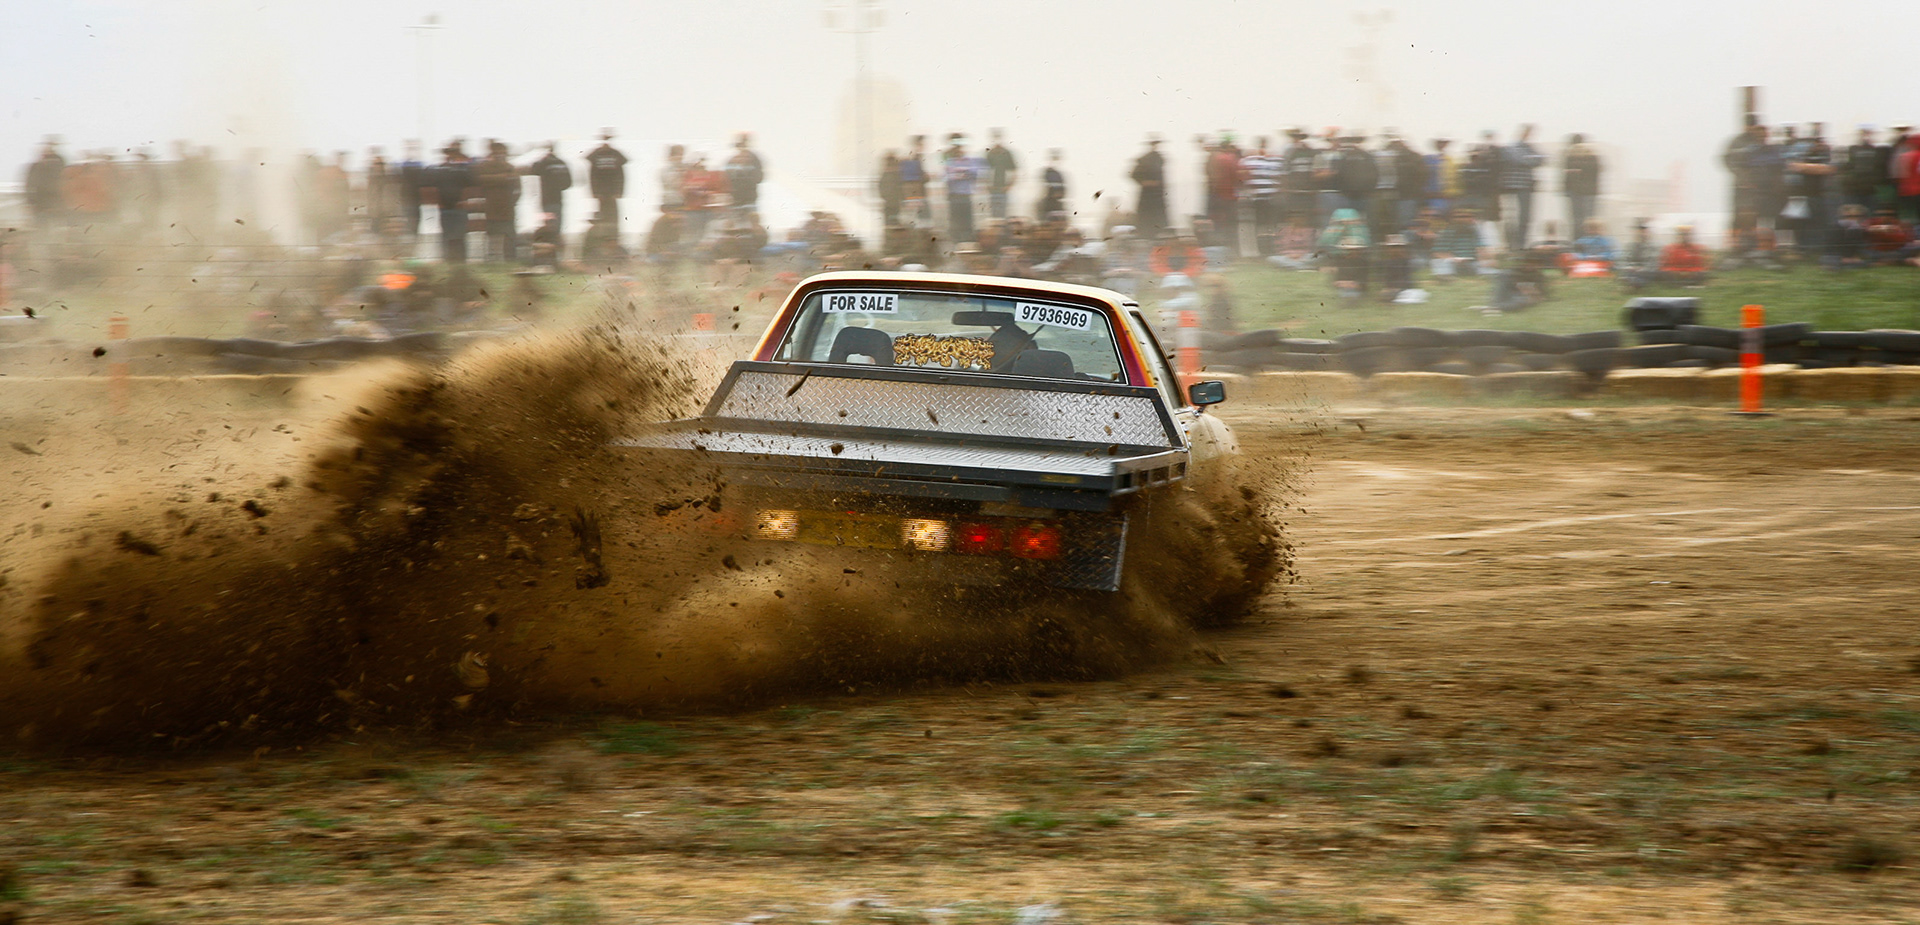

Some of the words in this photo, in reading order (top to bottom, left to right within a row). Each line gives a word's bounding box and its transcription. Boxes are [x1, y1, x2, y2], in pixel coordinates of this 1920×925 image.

[829, 296, 856, 311] FOR
[859, 296, 893, 311] SALE
[1022, 305, 1087, 328] 97936969
